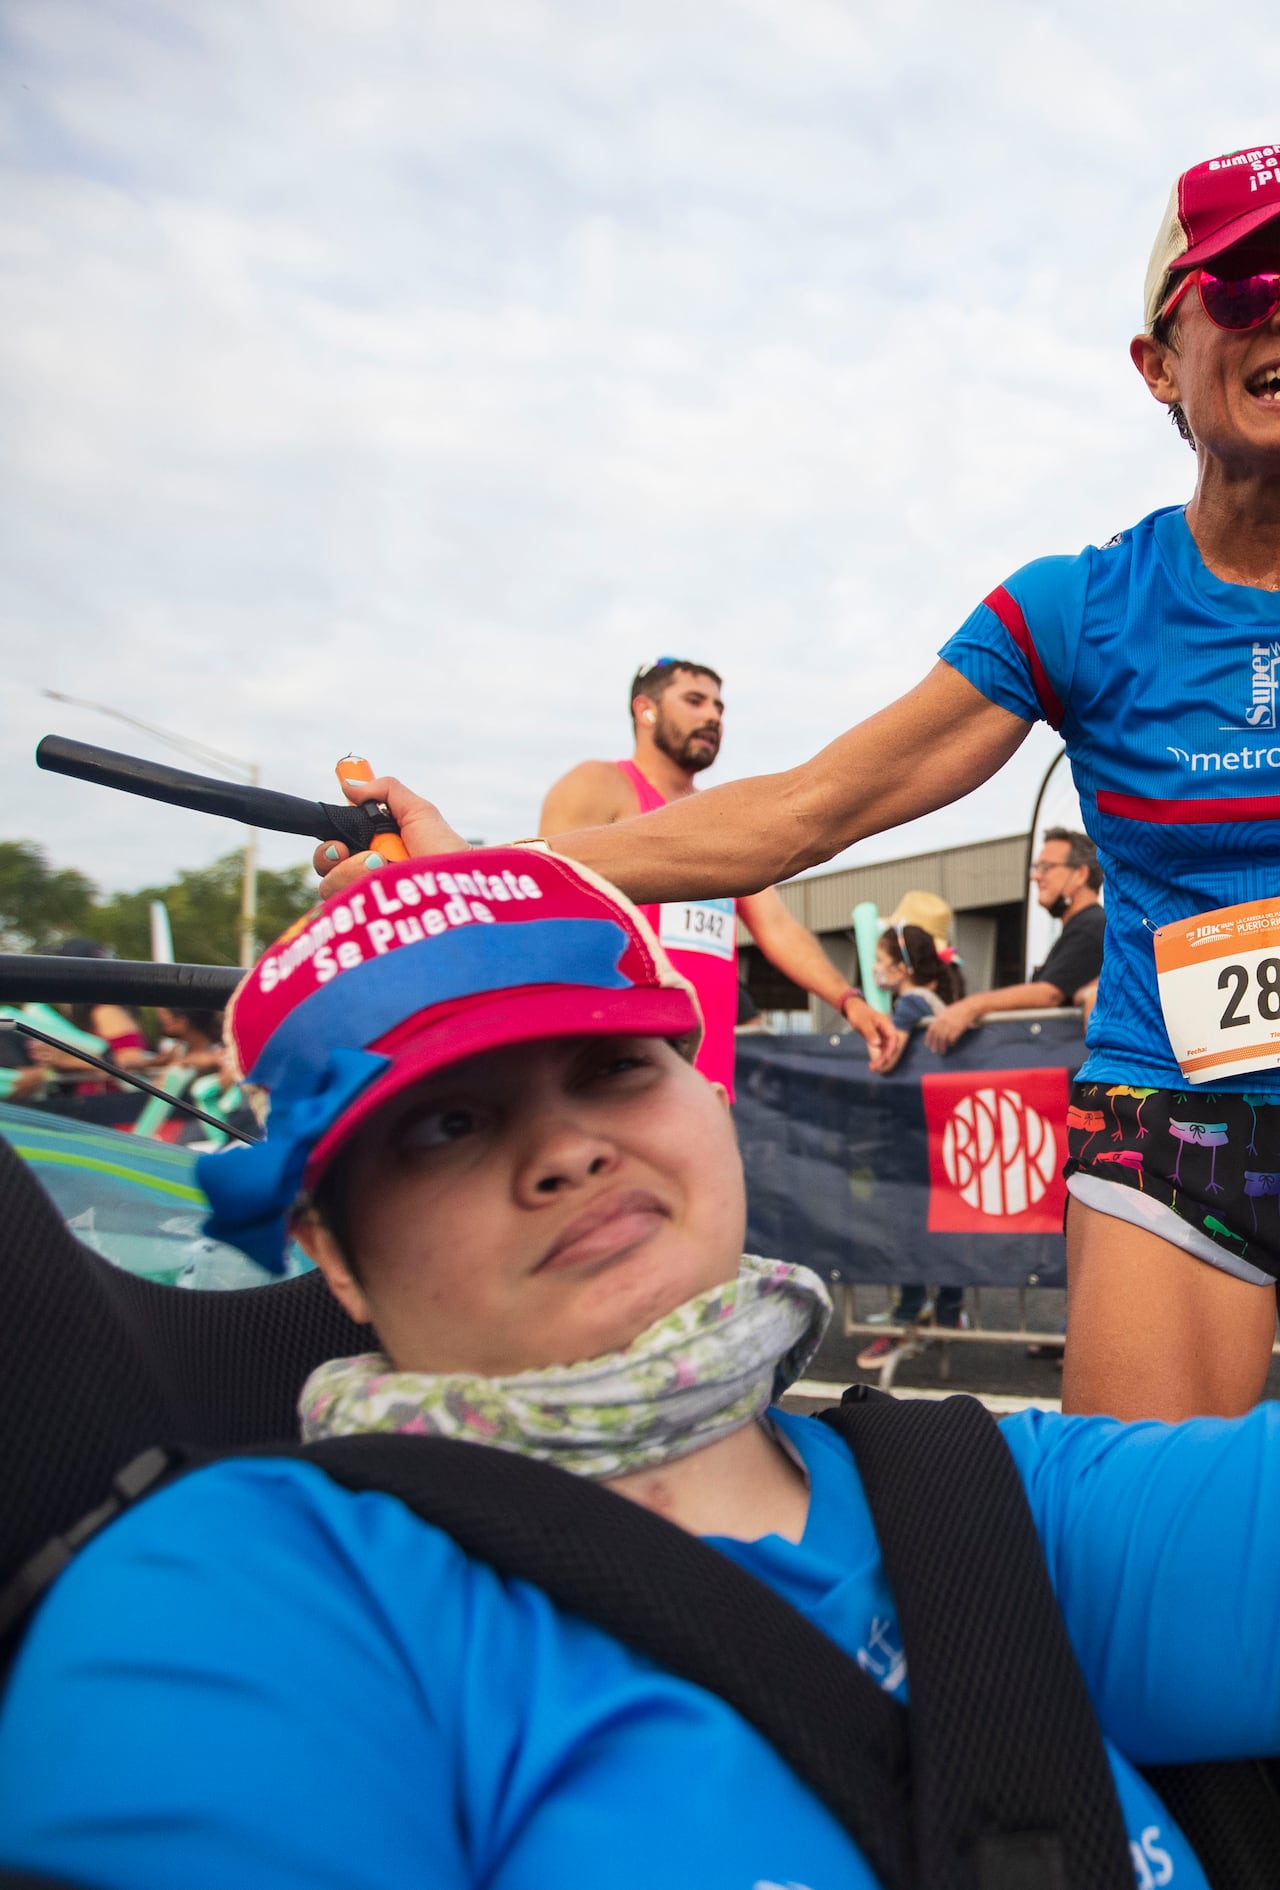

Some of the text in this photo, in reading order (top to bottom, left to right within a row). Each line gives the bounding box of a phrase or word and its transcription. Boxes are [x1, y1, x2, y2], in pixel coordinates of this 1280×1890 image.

[1208, 144, 1280, 171] Summer
[1250, 157, 1278, 171] Se
[1246, 642, 1278, 726] Super
[260, 869, 543, 992] Summer Levantate
[684, 909, 723, 938] 1342
[1197, 924, 1220, 938] 10K
[1237, 919, 1270, 933] PUERTO
[313, 893, 496, 983] Se Puede
[1187, 1047, 1207, 1056] Fecha:
